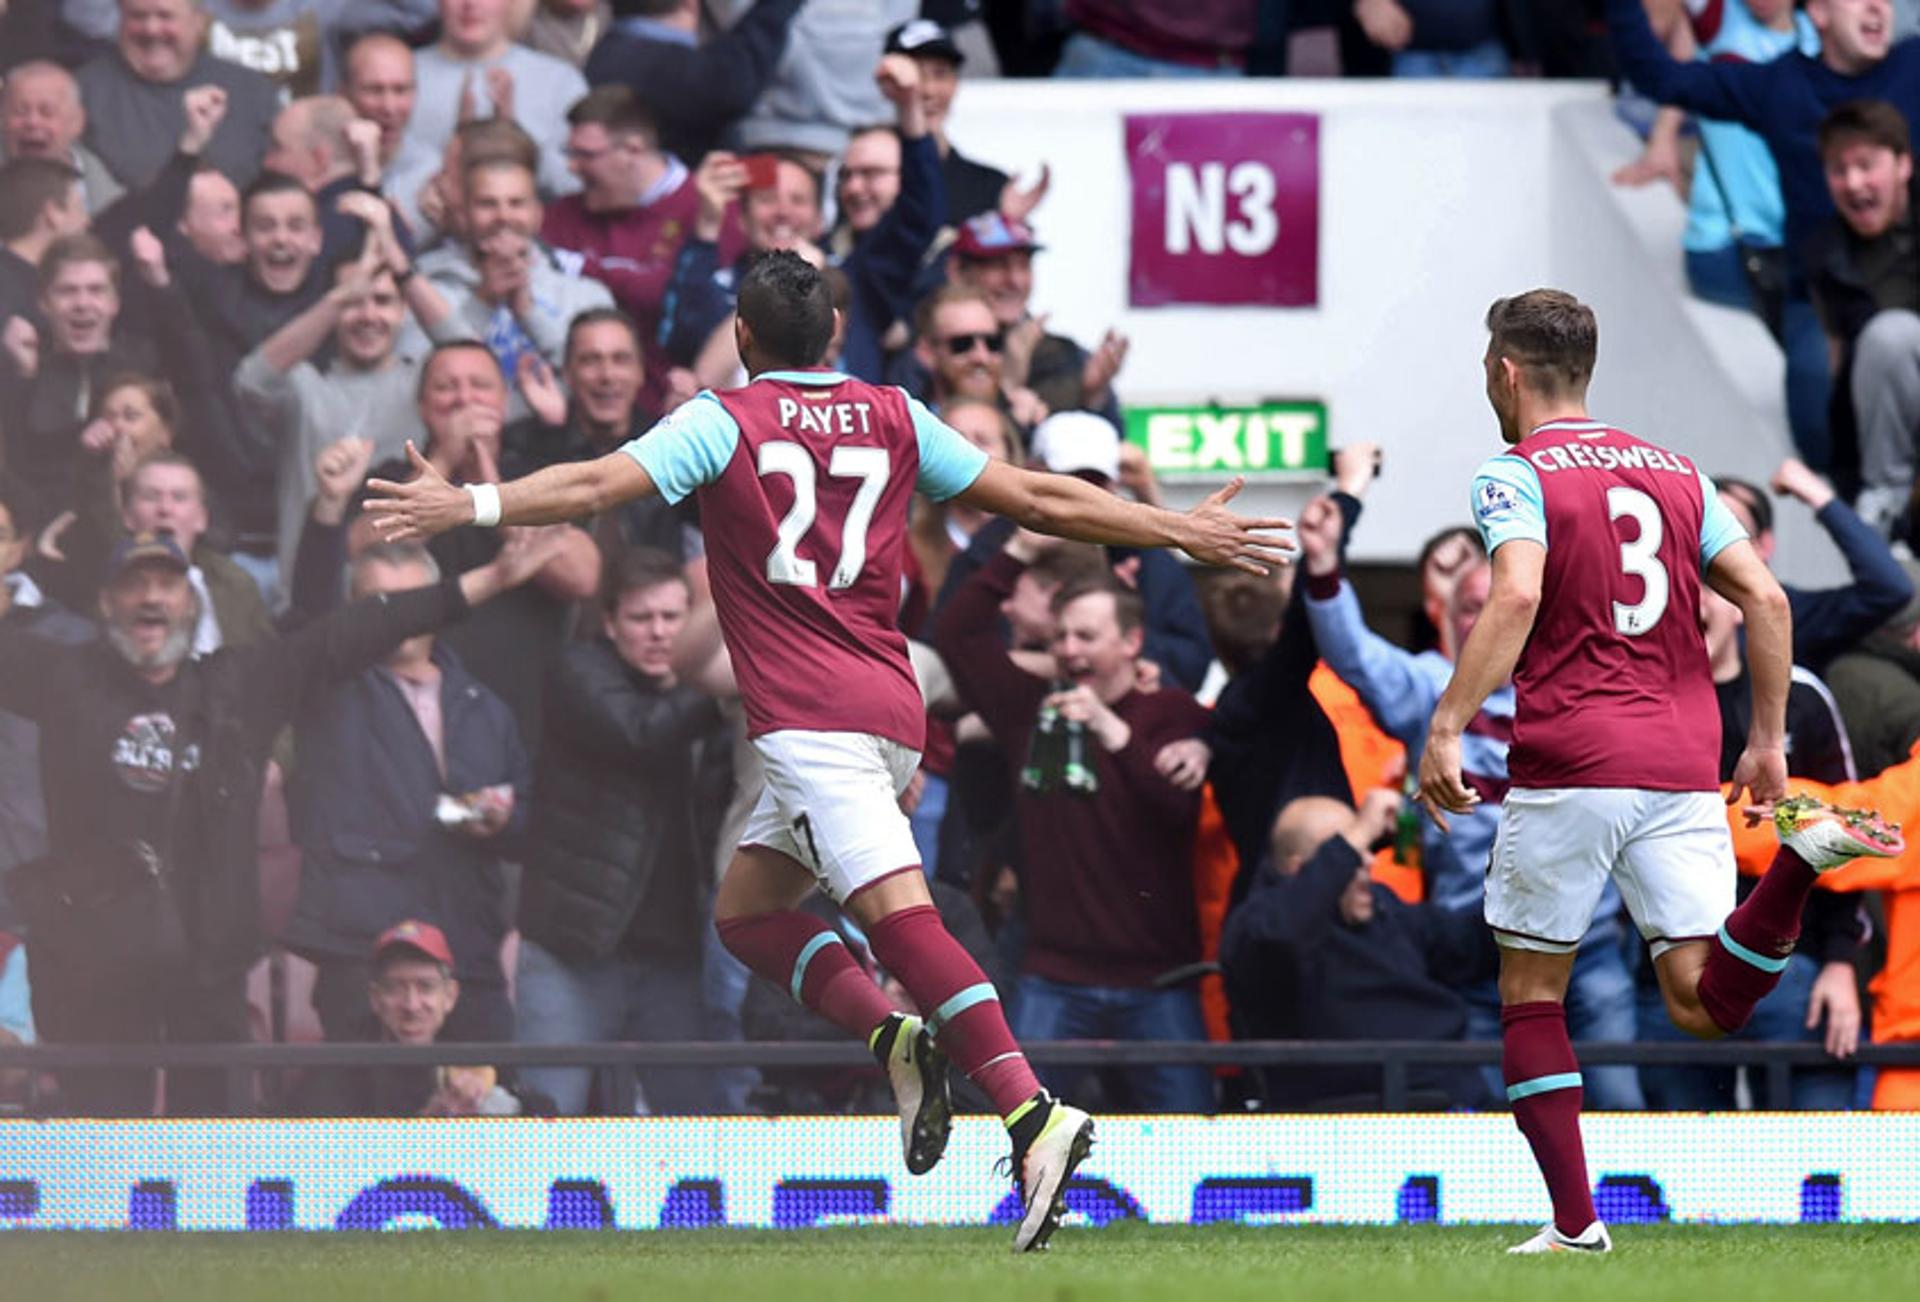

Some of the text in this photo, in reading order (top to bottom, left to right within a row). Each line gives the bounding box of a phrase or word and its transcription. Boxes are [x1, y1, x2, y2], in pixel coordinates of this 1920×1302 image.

[1165, 160, 1279, 256] N3
[779, 398, 870, 434] PAYET
[1147, 412, 1319, 469] EXIT
[1530, 442, 1692, 477] CRESSWELL
[758, 439, 890, 589] 27
[1606, 486, 1669, 636] 3
